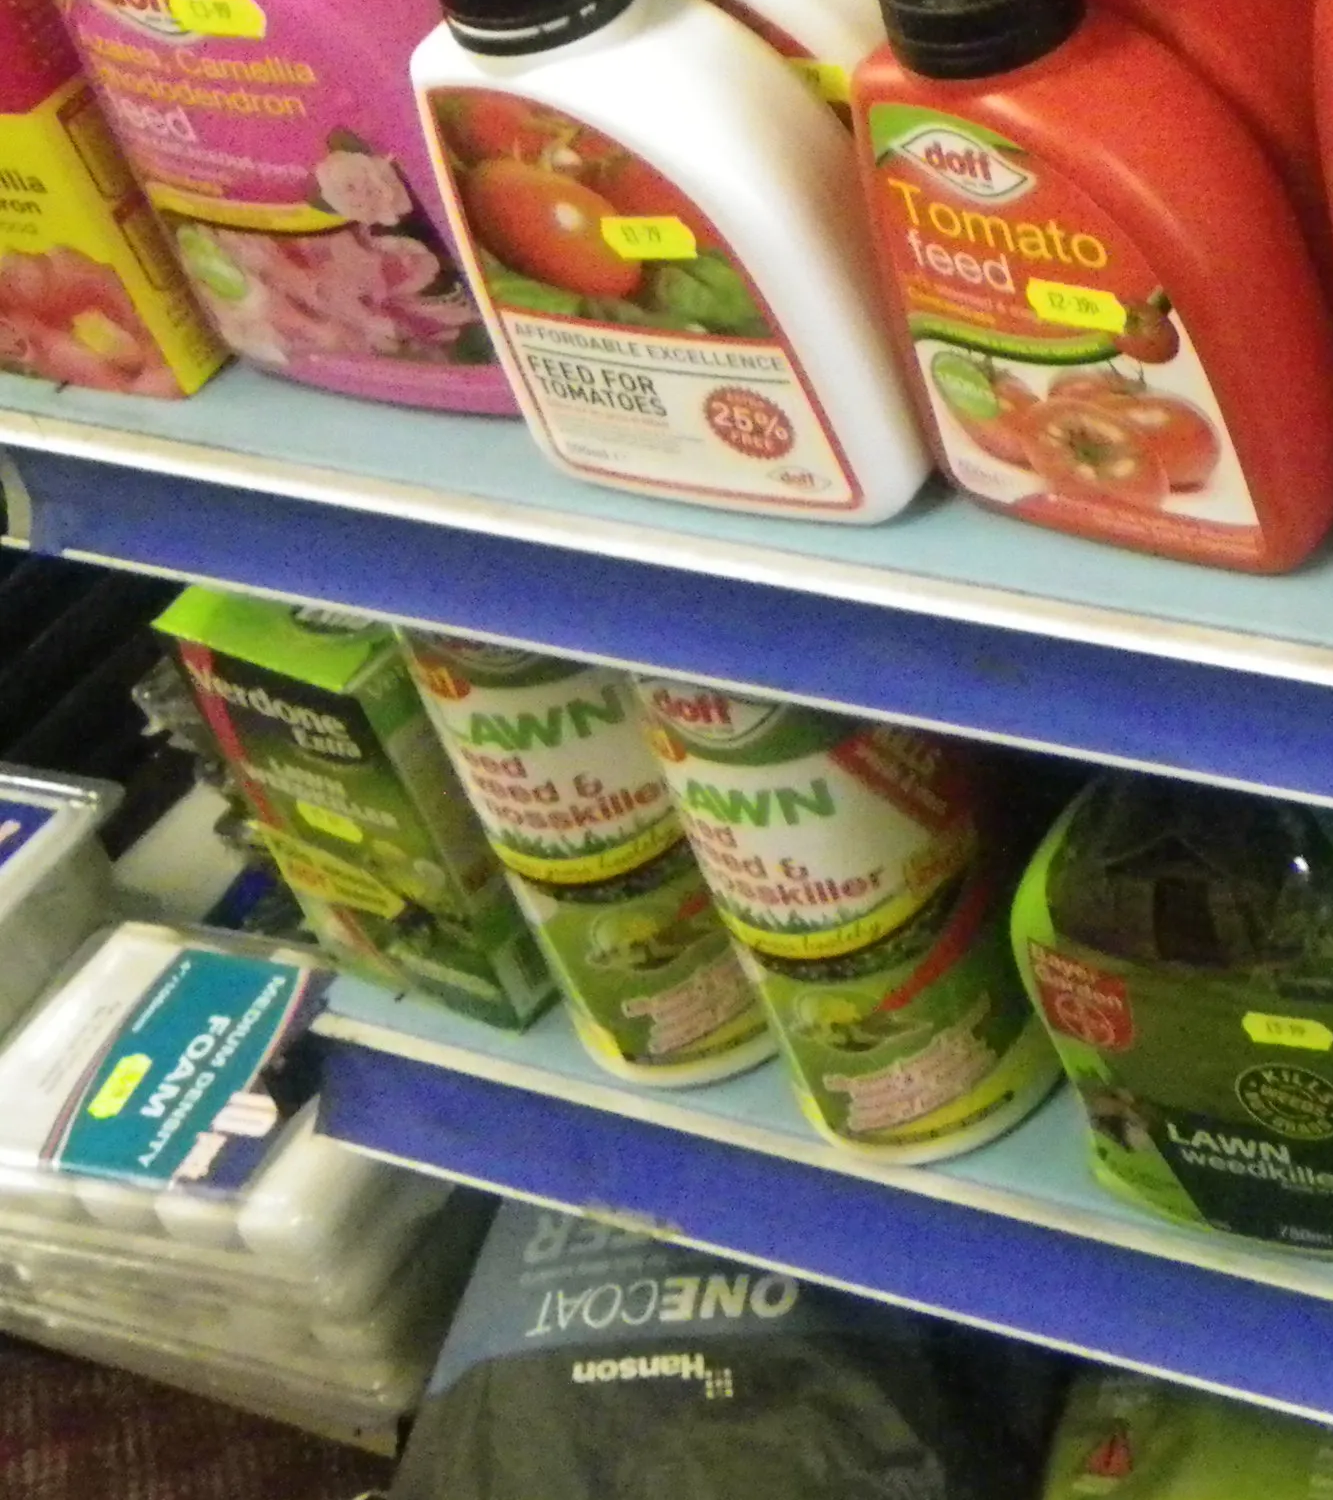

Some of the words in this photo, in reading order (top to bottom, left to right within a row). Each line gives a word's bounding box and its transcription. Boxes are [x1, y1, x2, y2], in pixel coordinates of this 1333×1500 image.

[921, 138, 992, 183] doff
[887, 176, 1109, 269] Tomato
[906, 230, 1016, 295] feed
[514, 321, 644, 358] AFFORDABLE
[646, 343, 788, 372] EXCELLENCE
[527, 354, 596, 386] FEED
[600, 368, 658, 397] FOR
[536, 374, 668, 418] TOMATOES
[713, 401, 790, 442] 25%
[213, 975, 288, 1071] MEDIUM
[139, 1014, 232, 1119] FOAM
[138, 1073, 217, 1168] DENSITY
[1167, 1122, 1290, 1163] LAWN
[571, 1353, 706, 1384] Hanson
